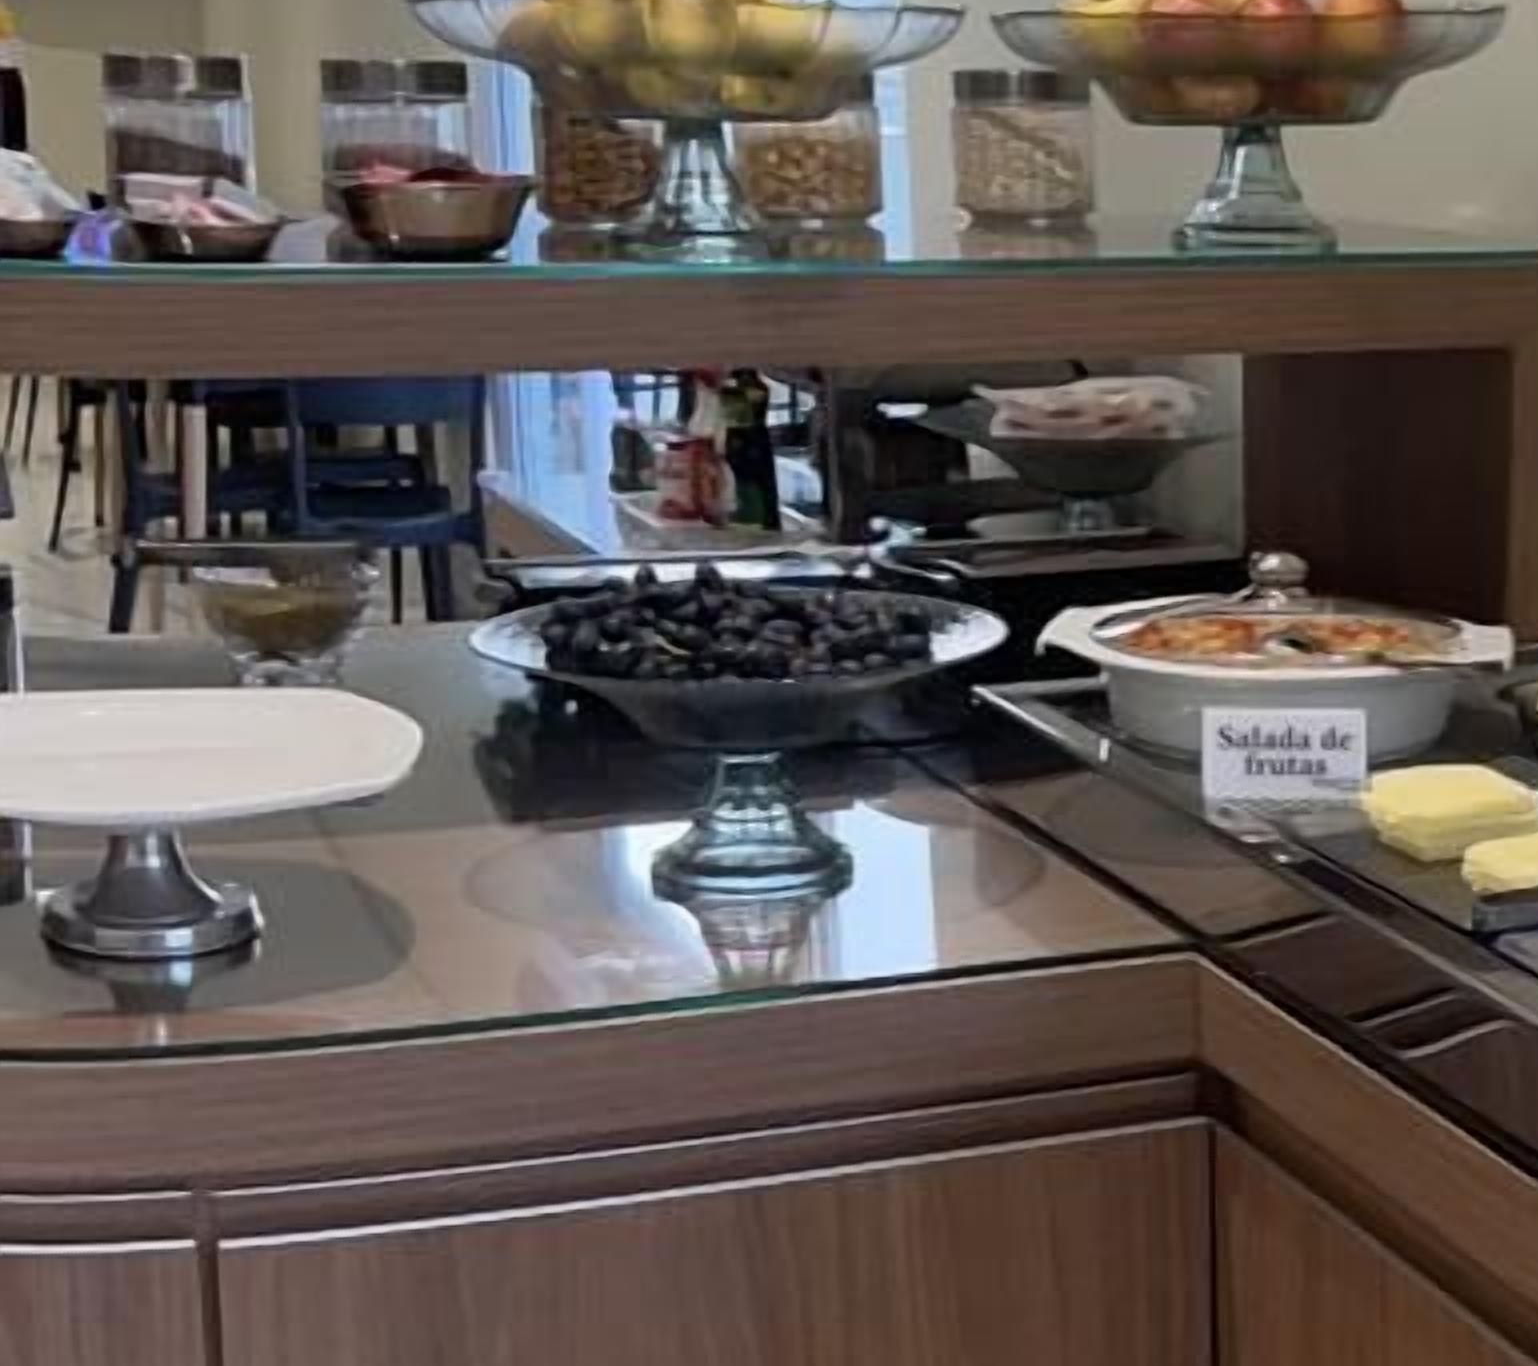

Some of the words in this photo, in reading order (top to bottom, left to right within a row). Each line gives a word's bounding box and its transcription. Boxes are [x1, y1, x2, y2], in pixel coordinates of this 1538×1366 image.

[1216, 721, 1312, 751] Salada
[1319, 723, 1355, 751] de
[1243, 756, 1328, 776] frutas
